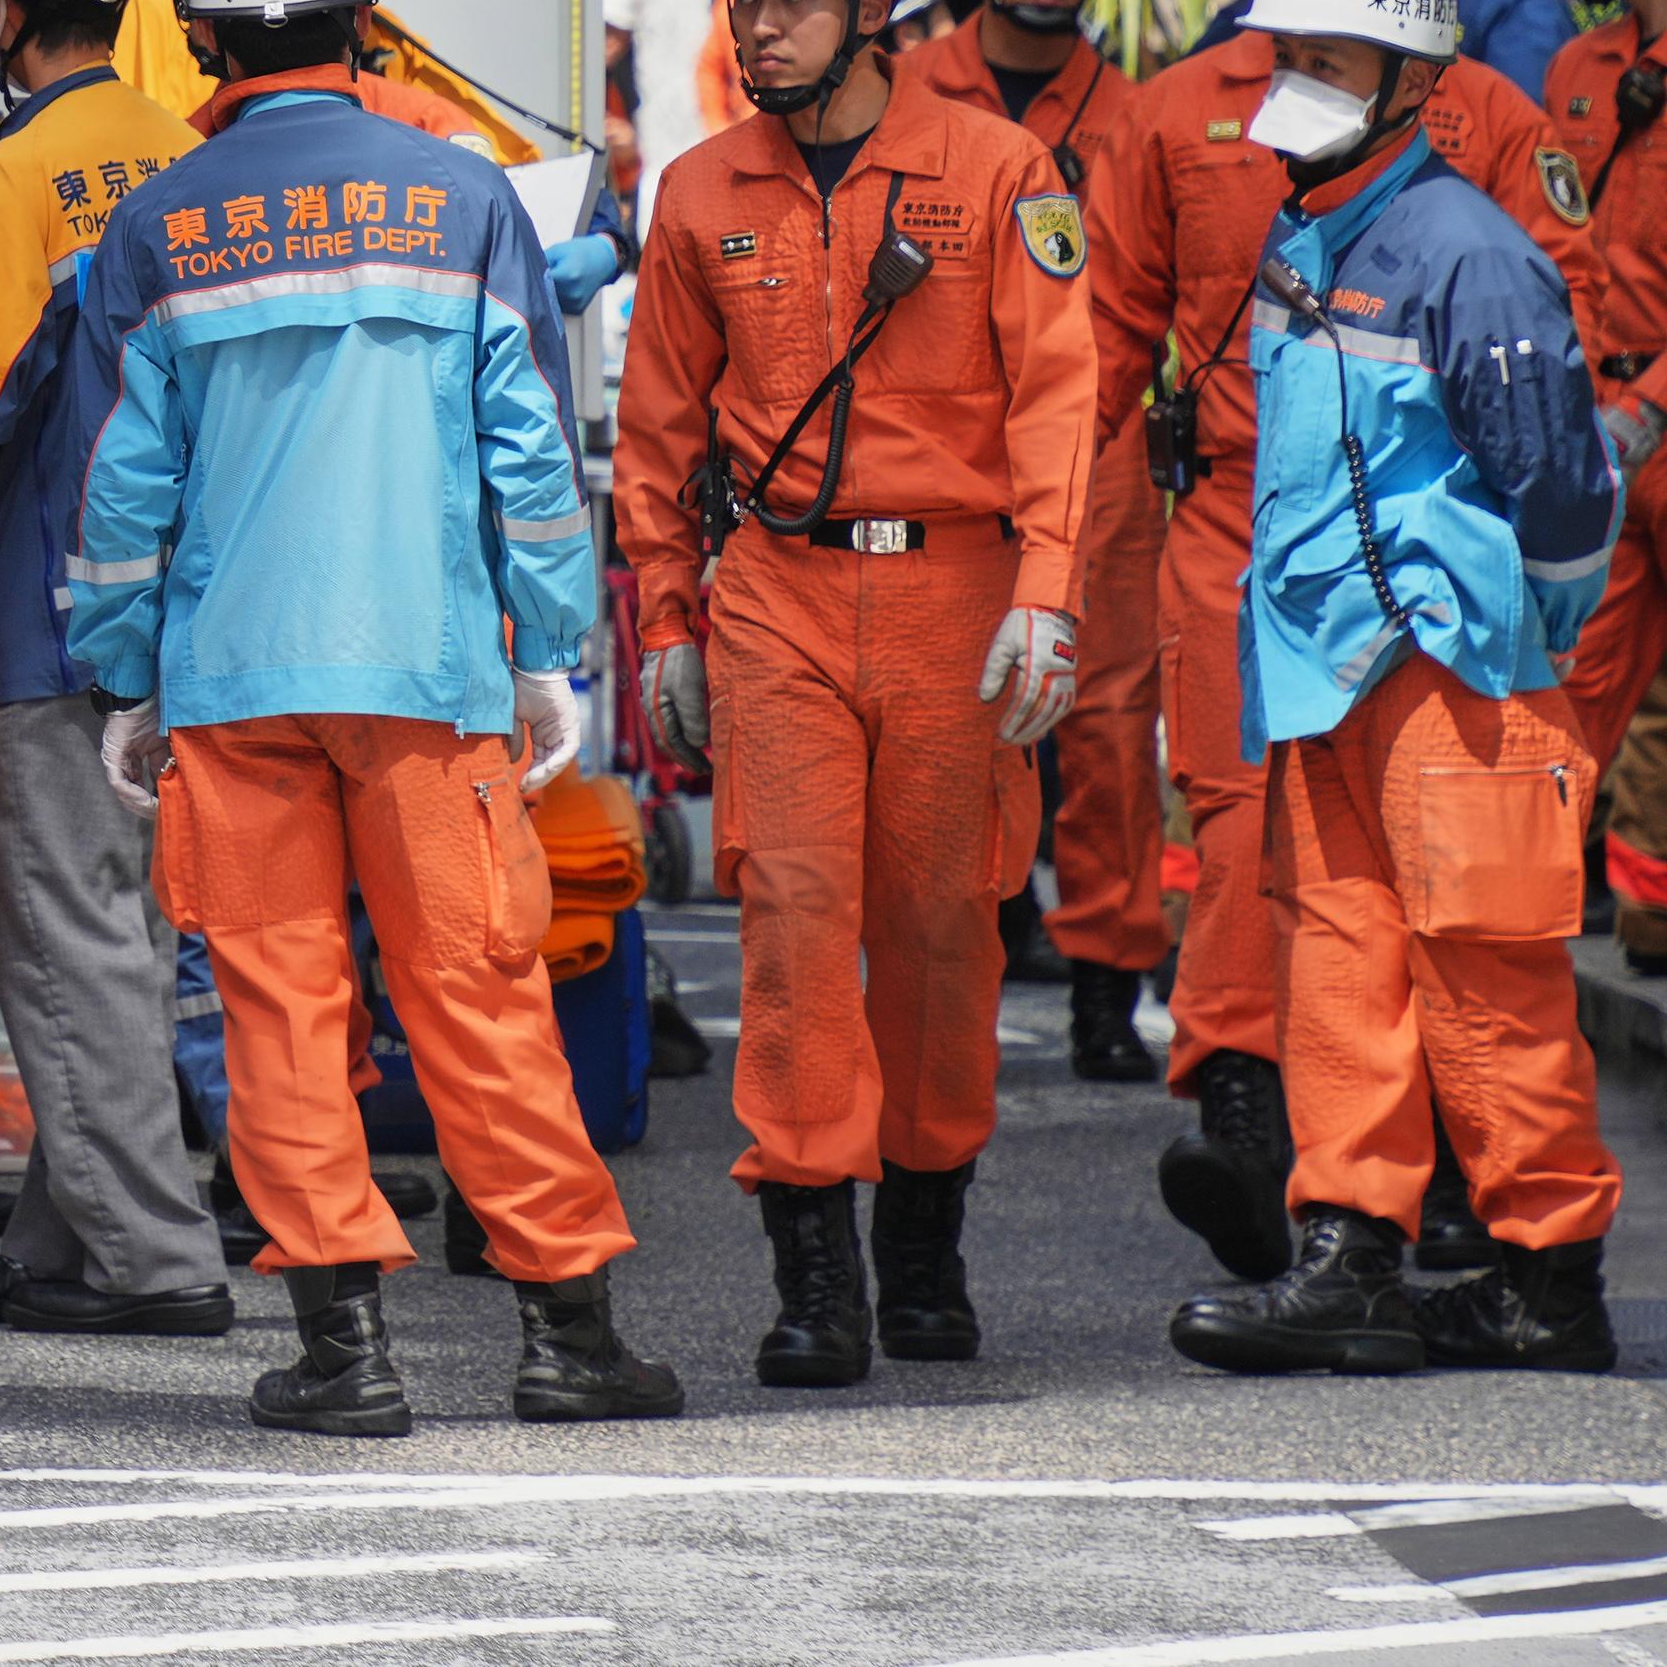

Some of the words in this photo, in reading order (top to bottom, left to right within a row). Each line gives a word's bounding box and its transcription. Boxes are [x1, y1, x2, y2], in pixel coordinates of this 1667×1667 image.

[67, 208, 114, 237] TOK
[163, 180, 447, 251] 東京消防庁
[903, 201, 965, 215] 東京消防庁
[169, 241, 273, 279] TOKYO
[284, 230, 353, 260] FIRE
[363, 227, 447, 257] DEPT.
